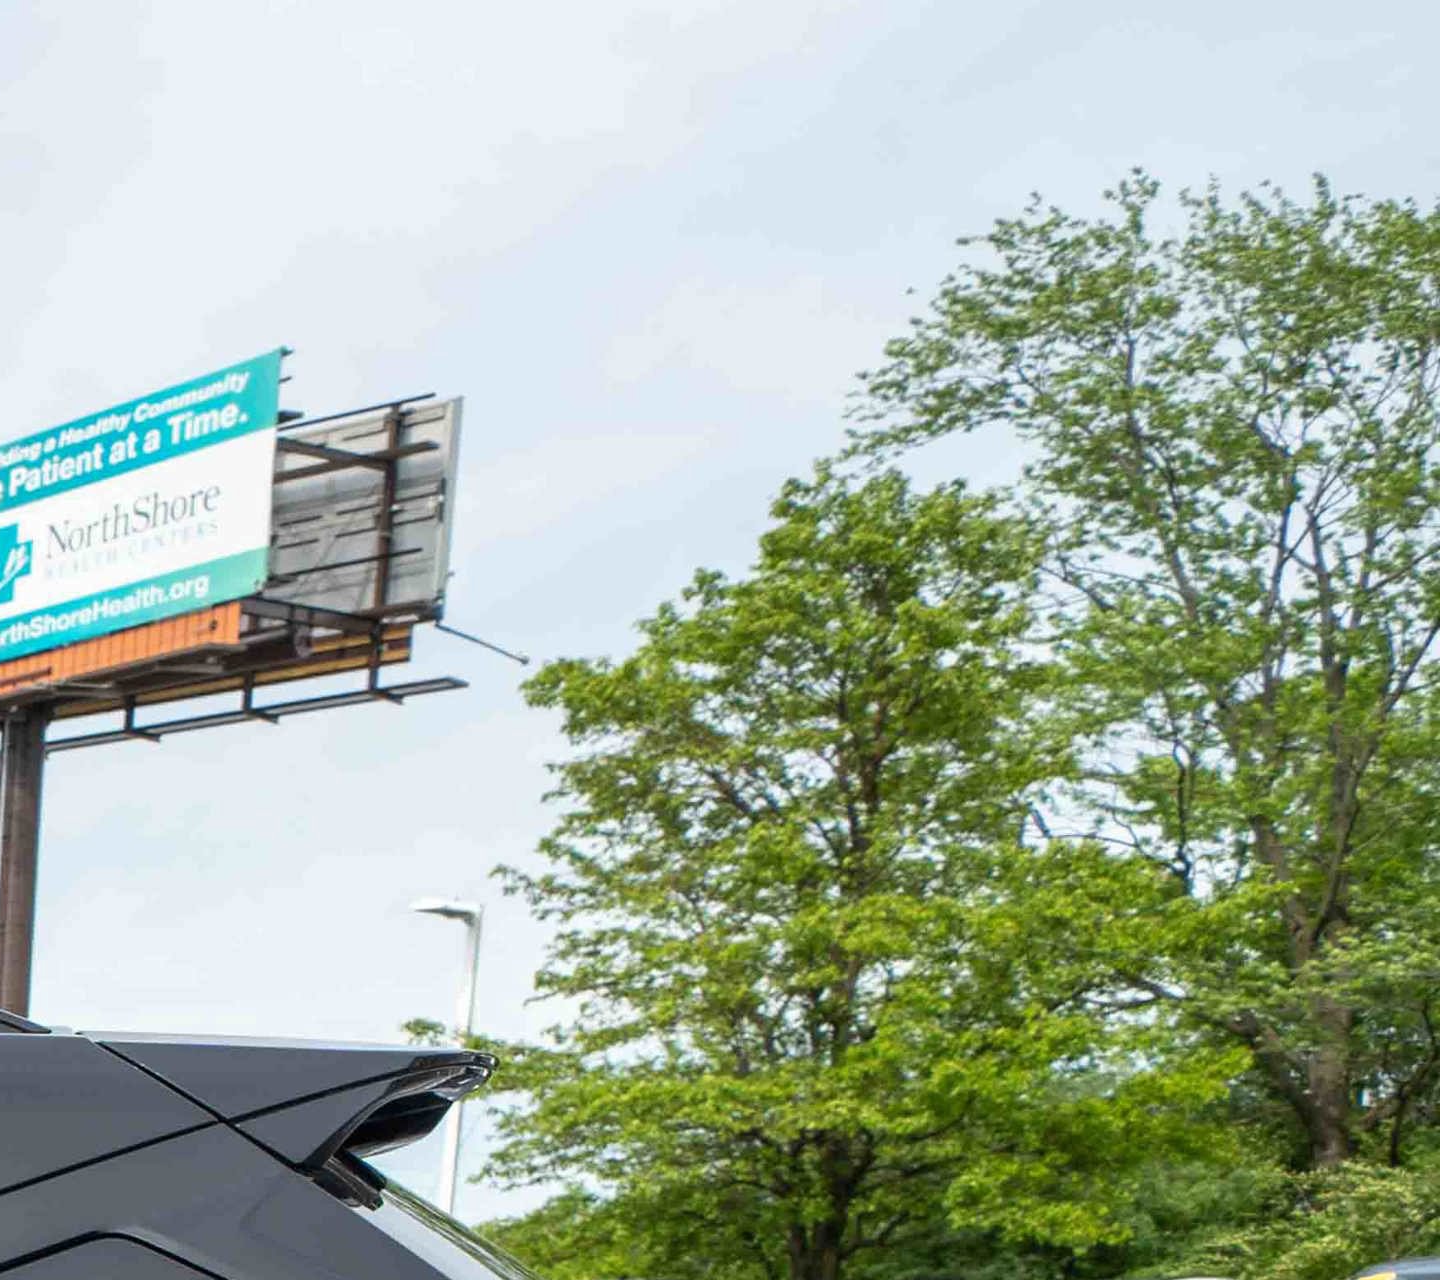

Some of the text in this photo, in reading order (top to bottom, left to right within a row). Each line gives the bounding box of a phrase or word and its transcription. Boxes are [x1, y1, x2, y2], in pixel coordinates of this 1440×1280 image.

[8, 442, 104, 496] Patient
[108, 431, 139, 465] at
[143, 428, 161, 454] a
[166, 401, 249, 445] Time.
[43, 437, 58, 453] a
[58, 412, 131, 449] Healthy
[133, 371, 250, 423] Community
[46, 486, 222, 559] NorthShore
